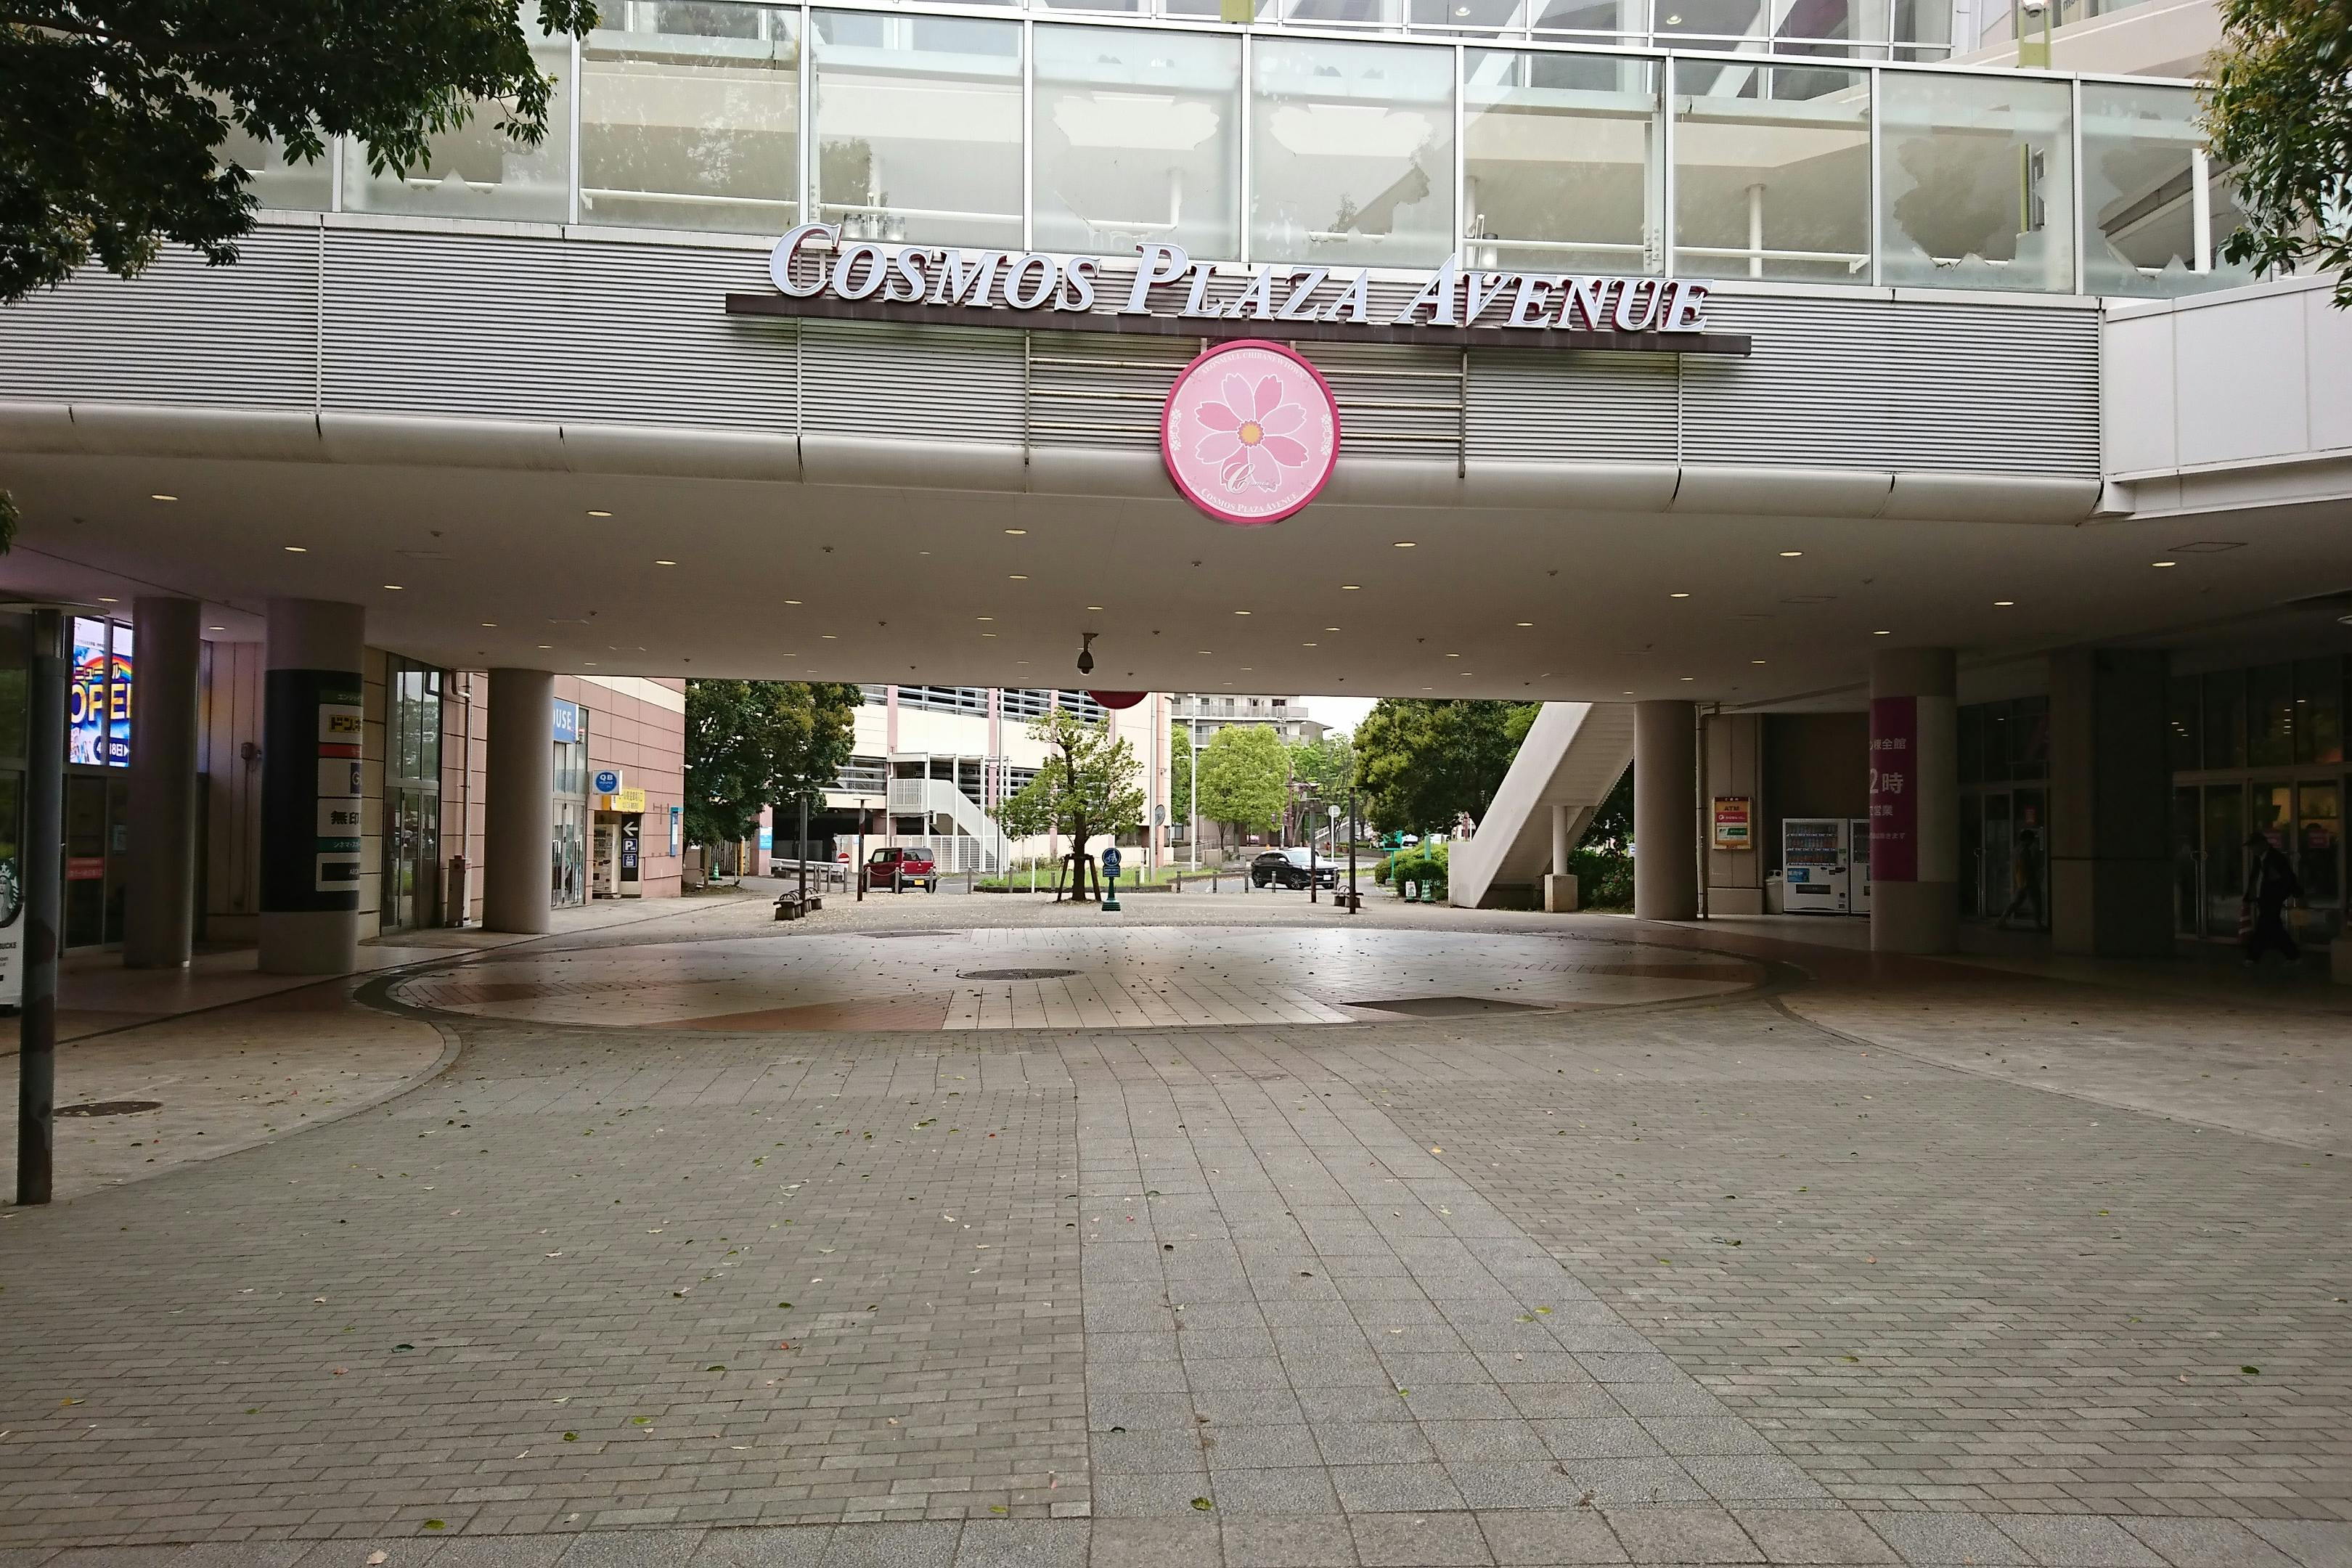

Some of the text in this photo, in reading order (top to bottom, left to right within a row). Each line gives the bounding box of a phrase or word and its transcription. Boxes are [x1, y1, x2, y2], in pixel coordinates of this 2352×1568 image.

[769, 223, 1715, 332] COSMOS PLAZA AVENUE
[1201, 352, 1242, 375] AEONMALL
[1201, 488, 1299, 513] COSMOS PLAZA AVENUE
[624, 840, 634, 851] P
